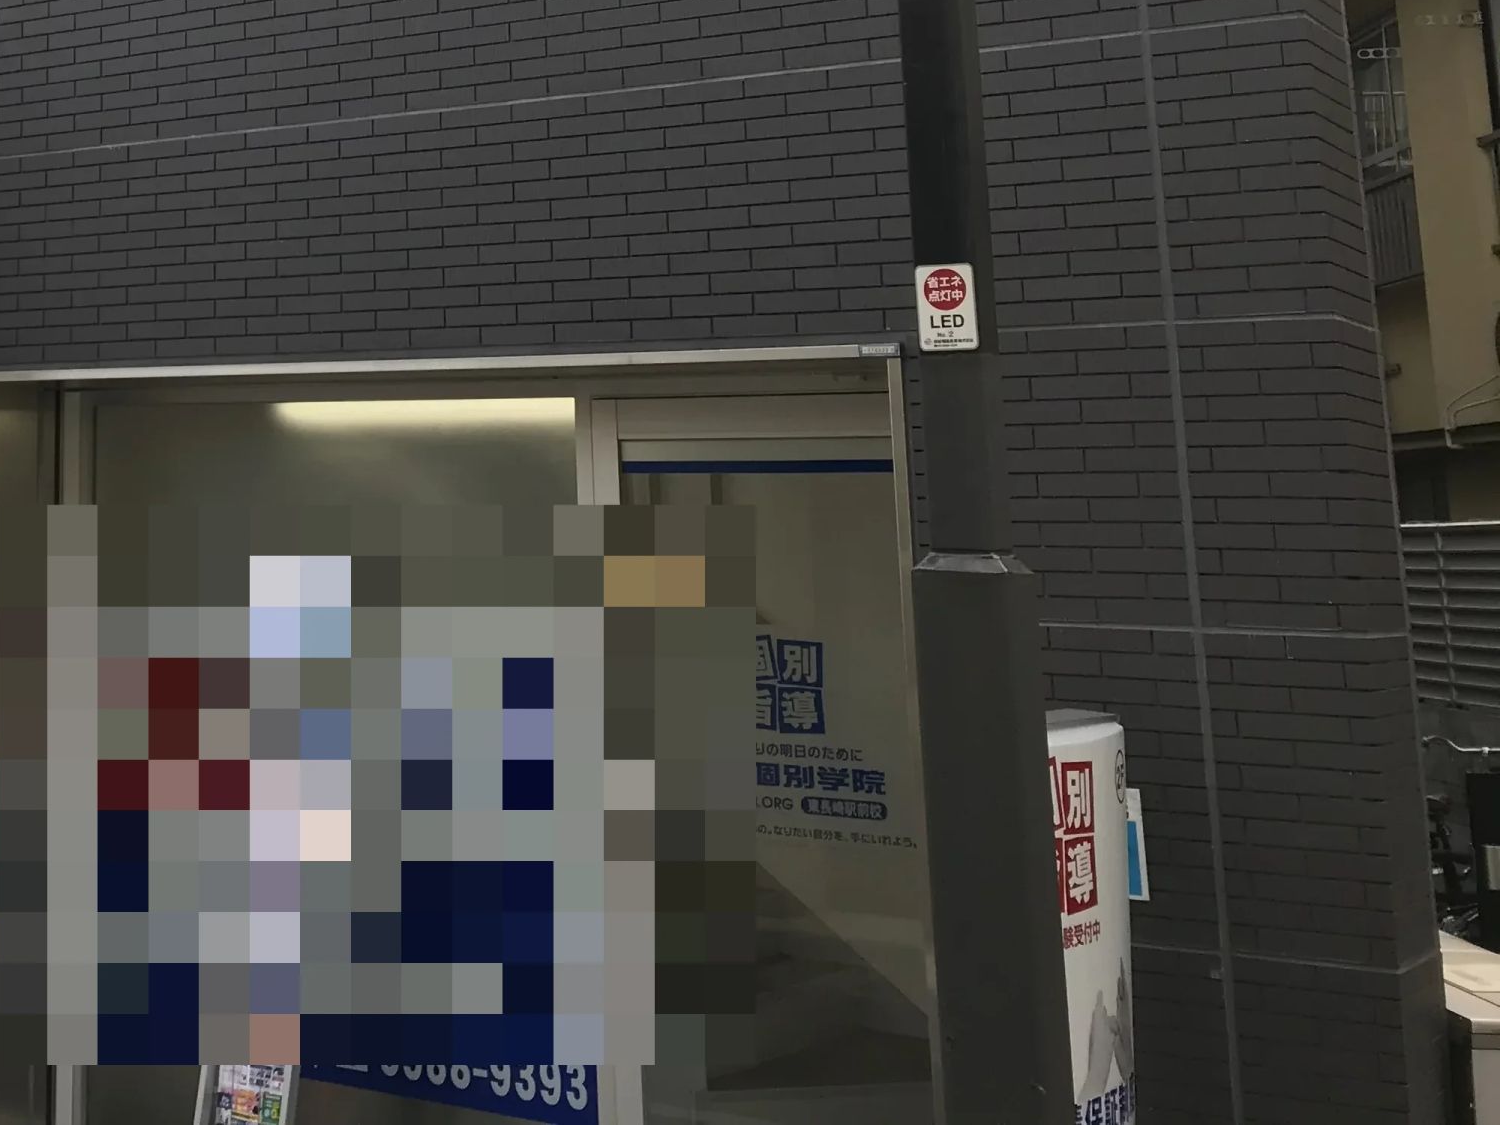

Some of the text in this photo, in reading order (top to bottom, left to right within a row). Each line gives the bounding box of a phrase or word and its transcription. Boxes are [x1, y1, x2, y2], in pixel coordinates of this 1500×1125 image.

[927, 275, 963, 289] 省エネ
[928, 289, 964, 302] 点灯中
[930, 314, 965, 329] LED
